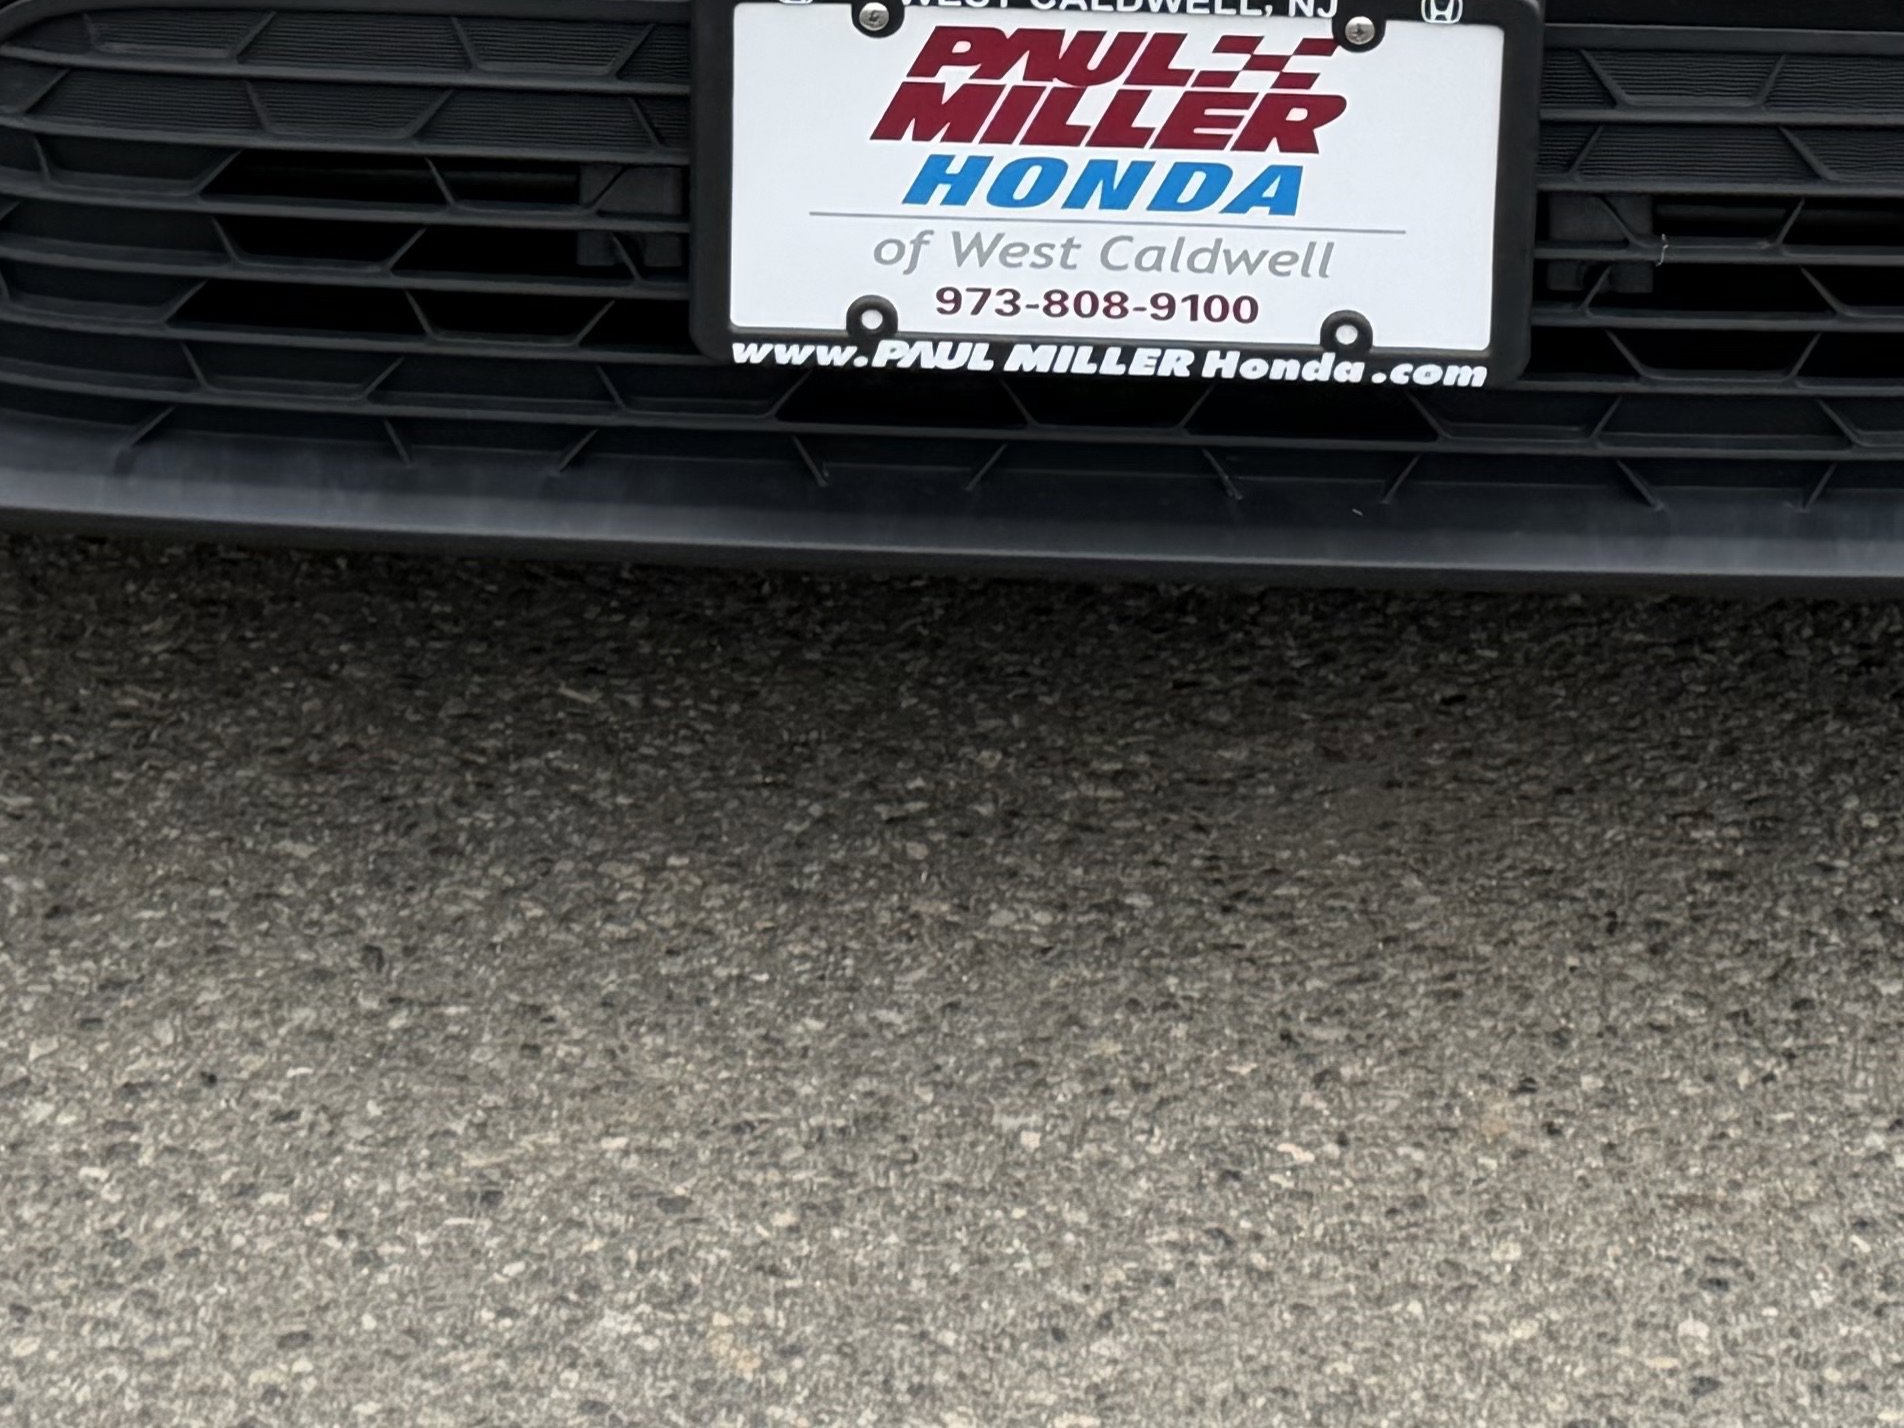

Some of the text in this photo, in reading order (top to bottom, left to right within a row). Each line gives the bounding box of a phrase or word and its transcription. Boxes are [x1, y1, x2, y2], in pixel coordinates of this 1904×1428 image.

[906, 25, 1196, 87] PAUL
[869, 81, 1348, 154] MILLER
[901, 154, 1305, 217] HONDA
[873, 229, 1335, 279] of West Caldwell
[935, 286, 1260, 325] 973-808-9100
